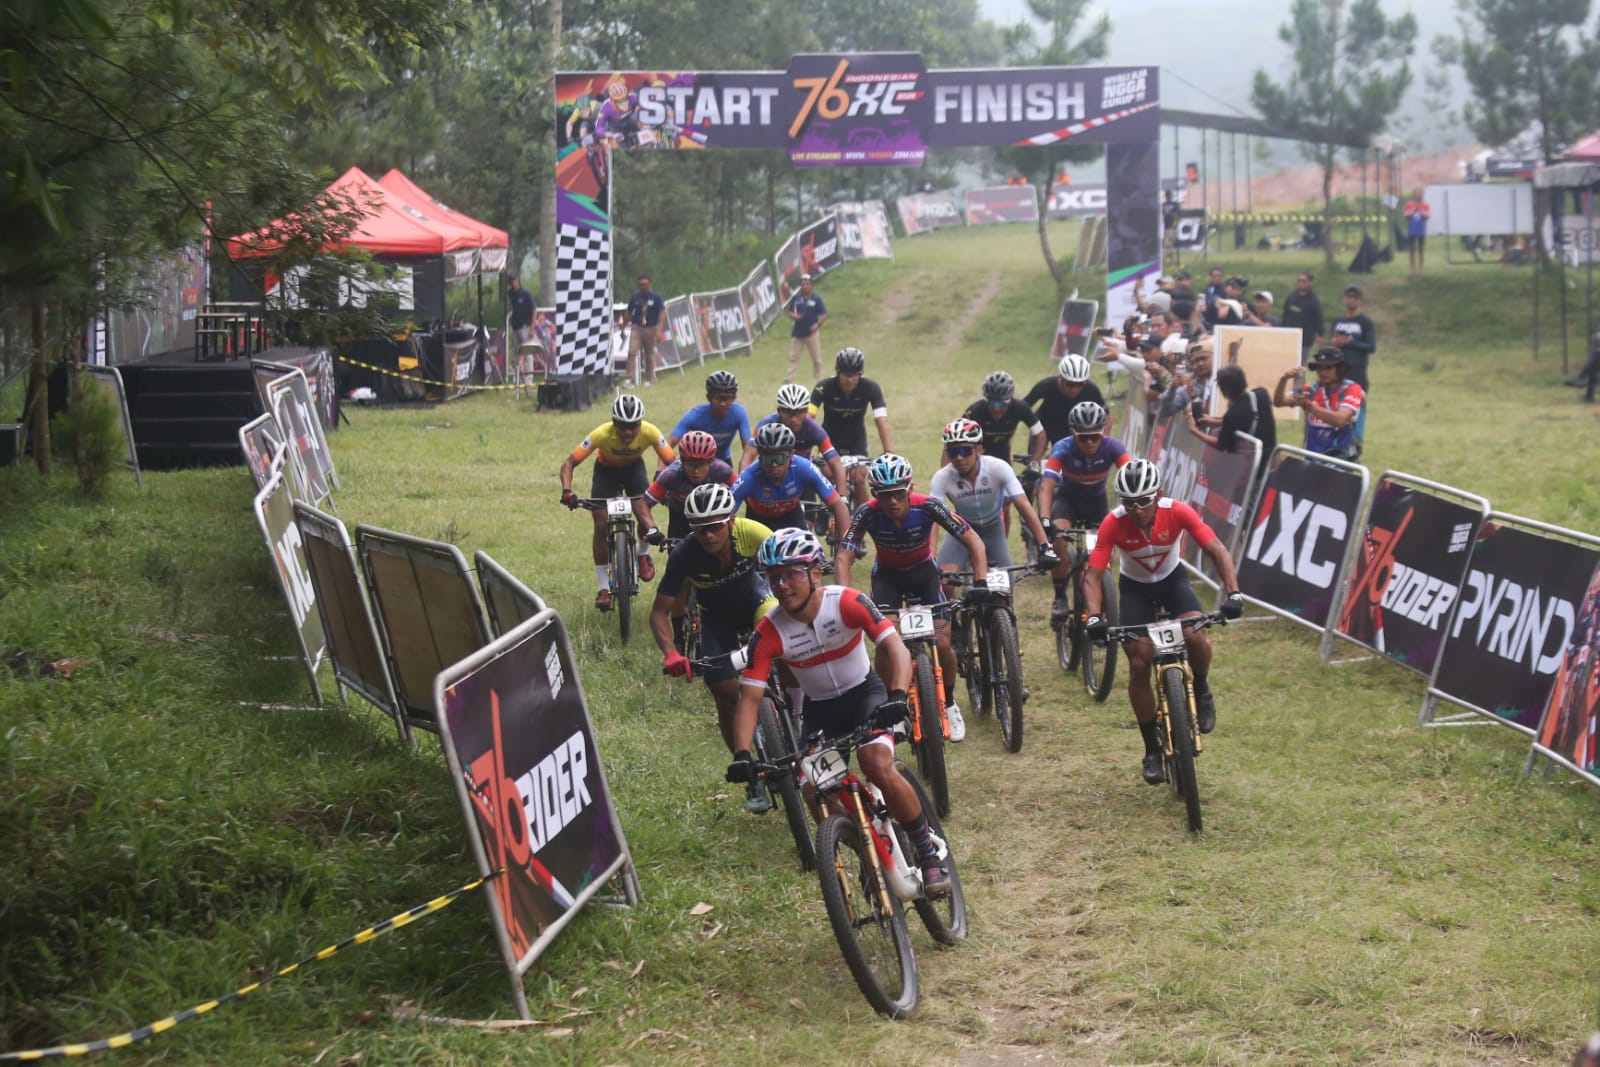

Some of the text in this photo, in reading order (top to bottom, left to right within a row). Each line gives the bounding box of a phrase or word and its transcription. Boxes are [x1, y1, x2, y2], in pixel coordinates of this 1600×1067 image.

[638, 87, 778, 125] START
[788, 58, 917, 139] 76 XC
[935, 82, 1085, 124] FINISH
[1104, 78, 1146, 98] NGGA
[615, 502, 625, 512] 19
[1247, 488, 1347, 589] IXC
[1380, 562, 1458, 630] RIDER
[909, 614, 925, 629] 12
[1158, 629, 1175, 645] 13
[515, 730, 592, 855] RIDER
